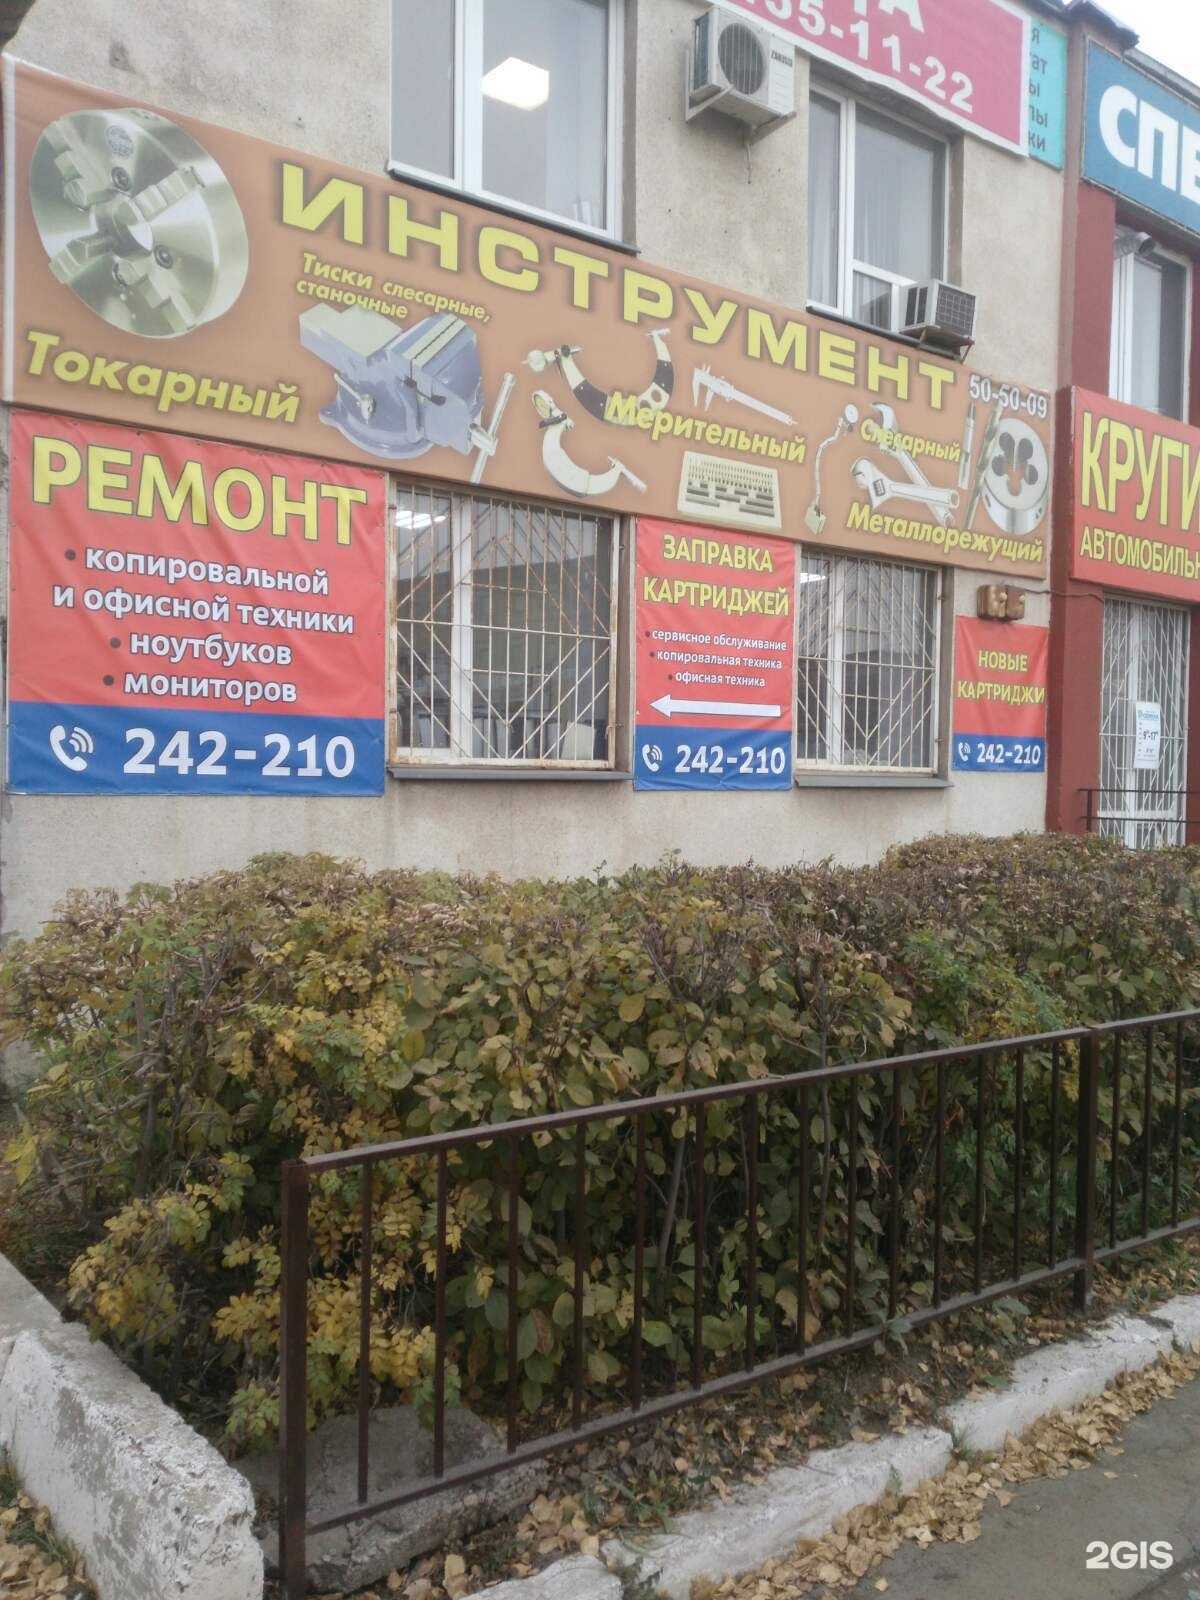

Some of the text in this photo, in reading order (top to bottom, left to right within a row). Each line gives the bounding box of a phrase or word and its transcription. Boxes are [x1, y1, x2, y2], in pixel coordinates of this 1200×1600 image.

[282, 162, 956, 411] ИНСТРУМЕНТ
[296, 280, 409, 319] станочные
[303, 252, 491, 323] Тиски слесарные,
[24, 330, 300, 424] Токарный
[968, 374, 1048, 419] 50-50-09
[603, 391, 807, 463] Мерительный
[860, 418, 961, 463] Слесарный
[32, 435, 368, 546] РЕМОНТ
[846, 501, 1045, 562] Металлорежущий
[85, 547, 329, 595] копировальной
[663, 533, 774, 573] ЗАПРАВКА
[53, 585, 355, 634] и офисной техники
[643, 576, 789, 617] КАРТРИДЖЕЙ
[130, 631, 292, 667] ноутбуков
[652, 629, 788, 651] сервисное обслуживание
[657, 650, 783, 670] копировальная техника
[978, 649, 1029, 672] НОВЫЕ
[124, 672, 297, 705] мониторов
[675, 670, 766, 688] офисная техника
[957, 681, 1045, 706] КАРТРИДЖИ
[123, 728, 355, 778] 242-210
[674, 744, 786, 776] 242-210
[976, 742, 1041, 765] 242-210
